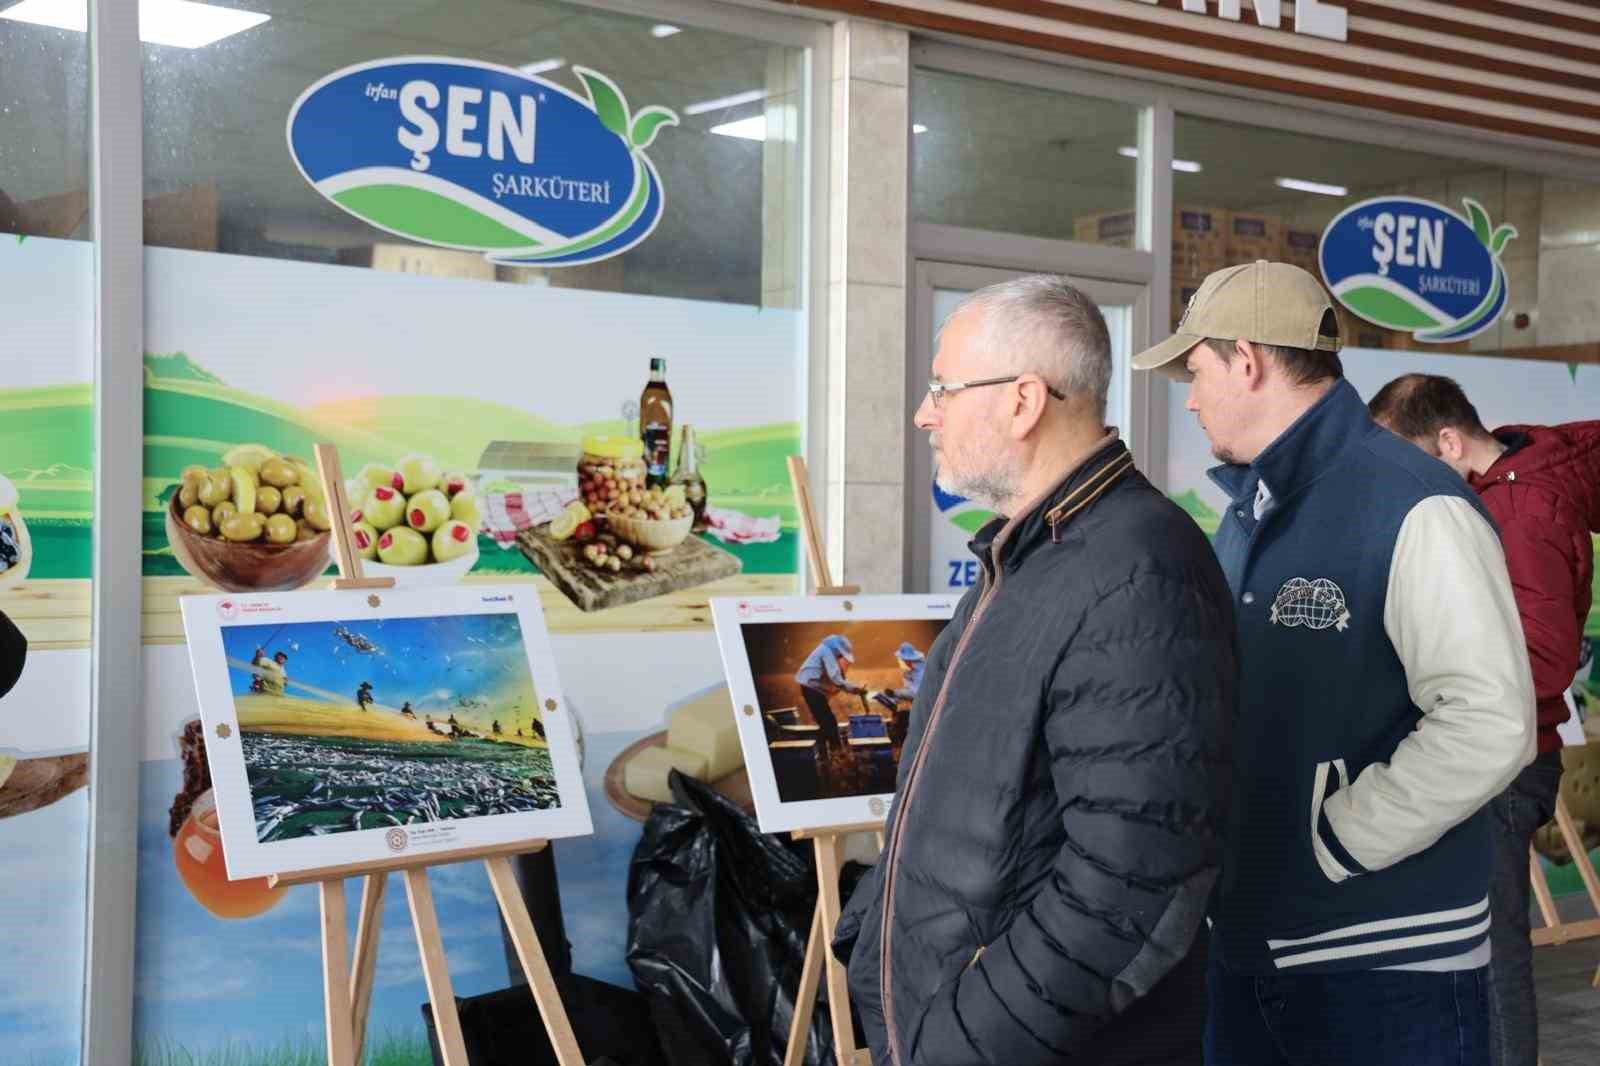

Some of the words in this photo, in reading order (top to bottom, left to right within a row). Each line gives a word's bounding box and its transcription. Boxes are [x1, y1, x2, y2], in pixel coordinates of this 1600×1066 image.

[398, 80, 537, 172] ŞEN
[492, 172, 610, 204] ŞARKÜTERİ
[1372, 212, 1444, 276] ŞEN
